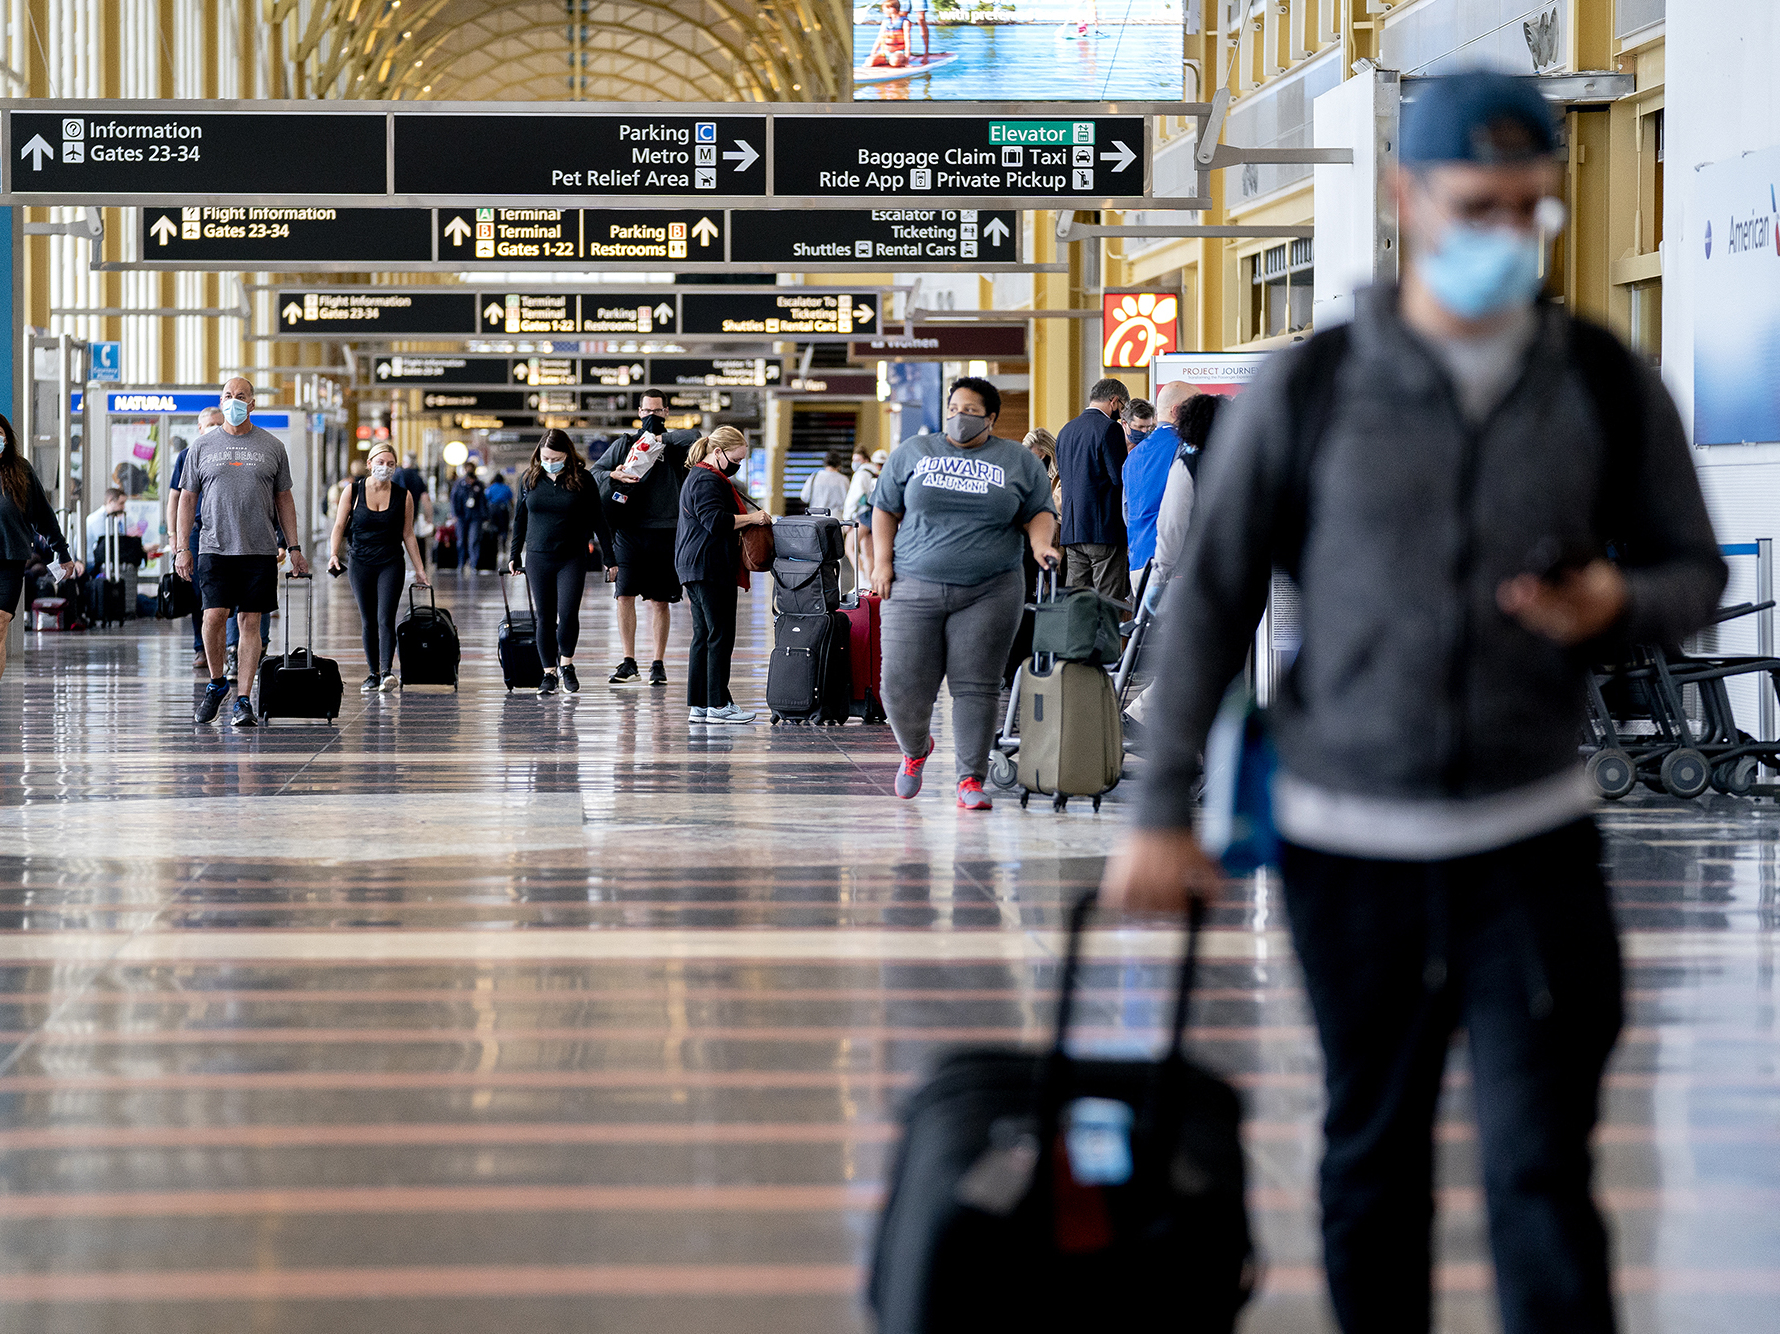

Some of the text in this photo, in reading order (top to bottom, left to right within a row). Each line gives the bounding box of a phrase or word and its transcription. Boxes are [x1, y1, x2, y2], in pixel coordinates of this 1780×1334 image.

[90, 121, 202, 139] Information
[619, 124, 713, 144] Parking C
[991, 124, 1067, 141] Elevator
[90, 145, 201, 162] Gates 23-34
[632, 147, 712, 164] Metro M
[858, 148, 1067, 170] Baggage Claim Taxi
[552, 169, 689, 187] Pet Relief Area
[819, 171, 1067, 192] Ride App Private Pickup
[203, 208, 337, 223] Flight Information
[497, 209, 562, 221] Terminal
[871, 210, 936, 221] Escalator
[203, 223, 290, 239] Gates 23-34
[497, 224, 562, 239] Terminal
[610, 225, 666, 242] Parking
[891, 225, 957, 242] Ticketing
[1728, 208, 1769, 255] American
[497, 241, 575, 257] Gates 1-22
[590, 241, 666, 257] Restrooms
[792, 242, 957, 257] Shuttles Rental Cars
[318, 295, 412, 309] Flight Information
[520, 296, 566, 307] Terminal
[776, 296, 837, 308] Escalator To
[319, 307, 349, 320] Gates
[520, 308, 566, 320] Terminal
[597, 308, 637, 321] Parking
[790, 308, 838, 321] Ticketing
[584, 320, 637, 332] Restrooms
[1182, 367, 1219, 375] PROJECT
[114, 395, 178, 411] NATURAL
[234, 450, 265, 463] BEACH
[922, 472, 989, 494] ALUMNI
